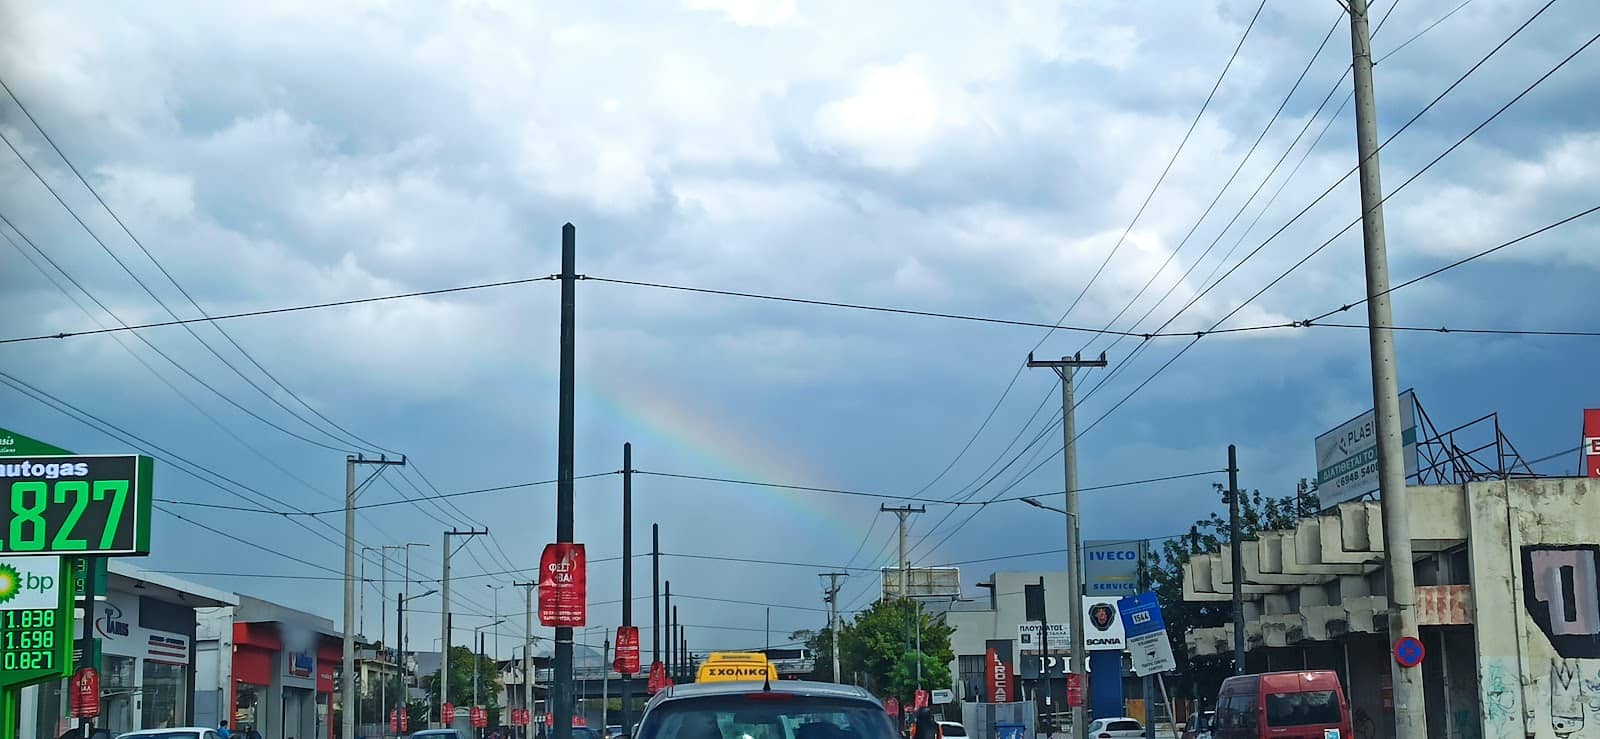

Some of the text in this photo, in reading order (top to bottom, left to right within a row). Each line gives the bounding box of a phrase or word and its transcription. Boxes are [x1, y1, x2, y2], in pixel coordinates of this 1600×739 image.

[1347, 420, 1375, 447] PLASI
[1089, 551, 1136, 561] IVECO
[26, 571, 54, 594] bp
[6, 610, 54, 629] 1.838
[5, 631, 54, 650] 1.698
[1087, 638, 1121, 646] SCANIA
[4, 651, 52, 670] 0.827
[709, 668, 767, 677] ΣΧΟΛΙΚΟ
